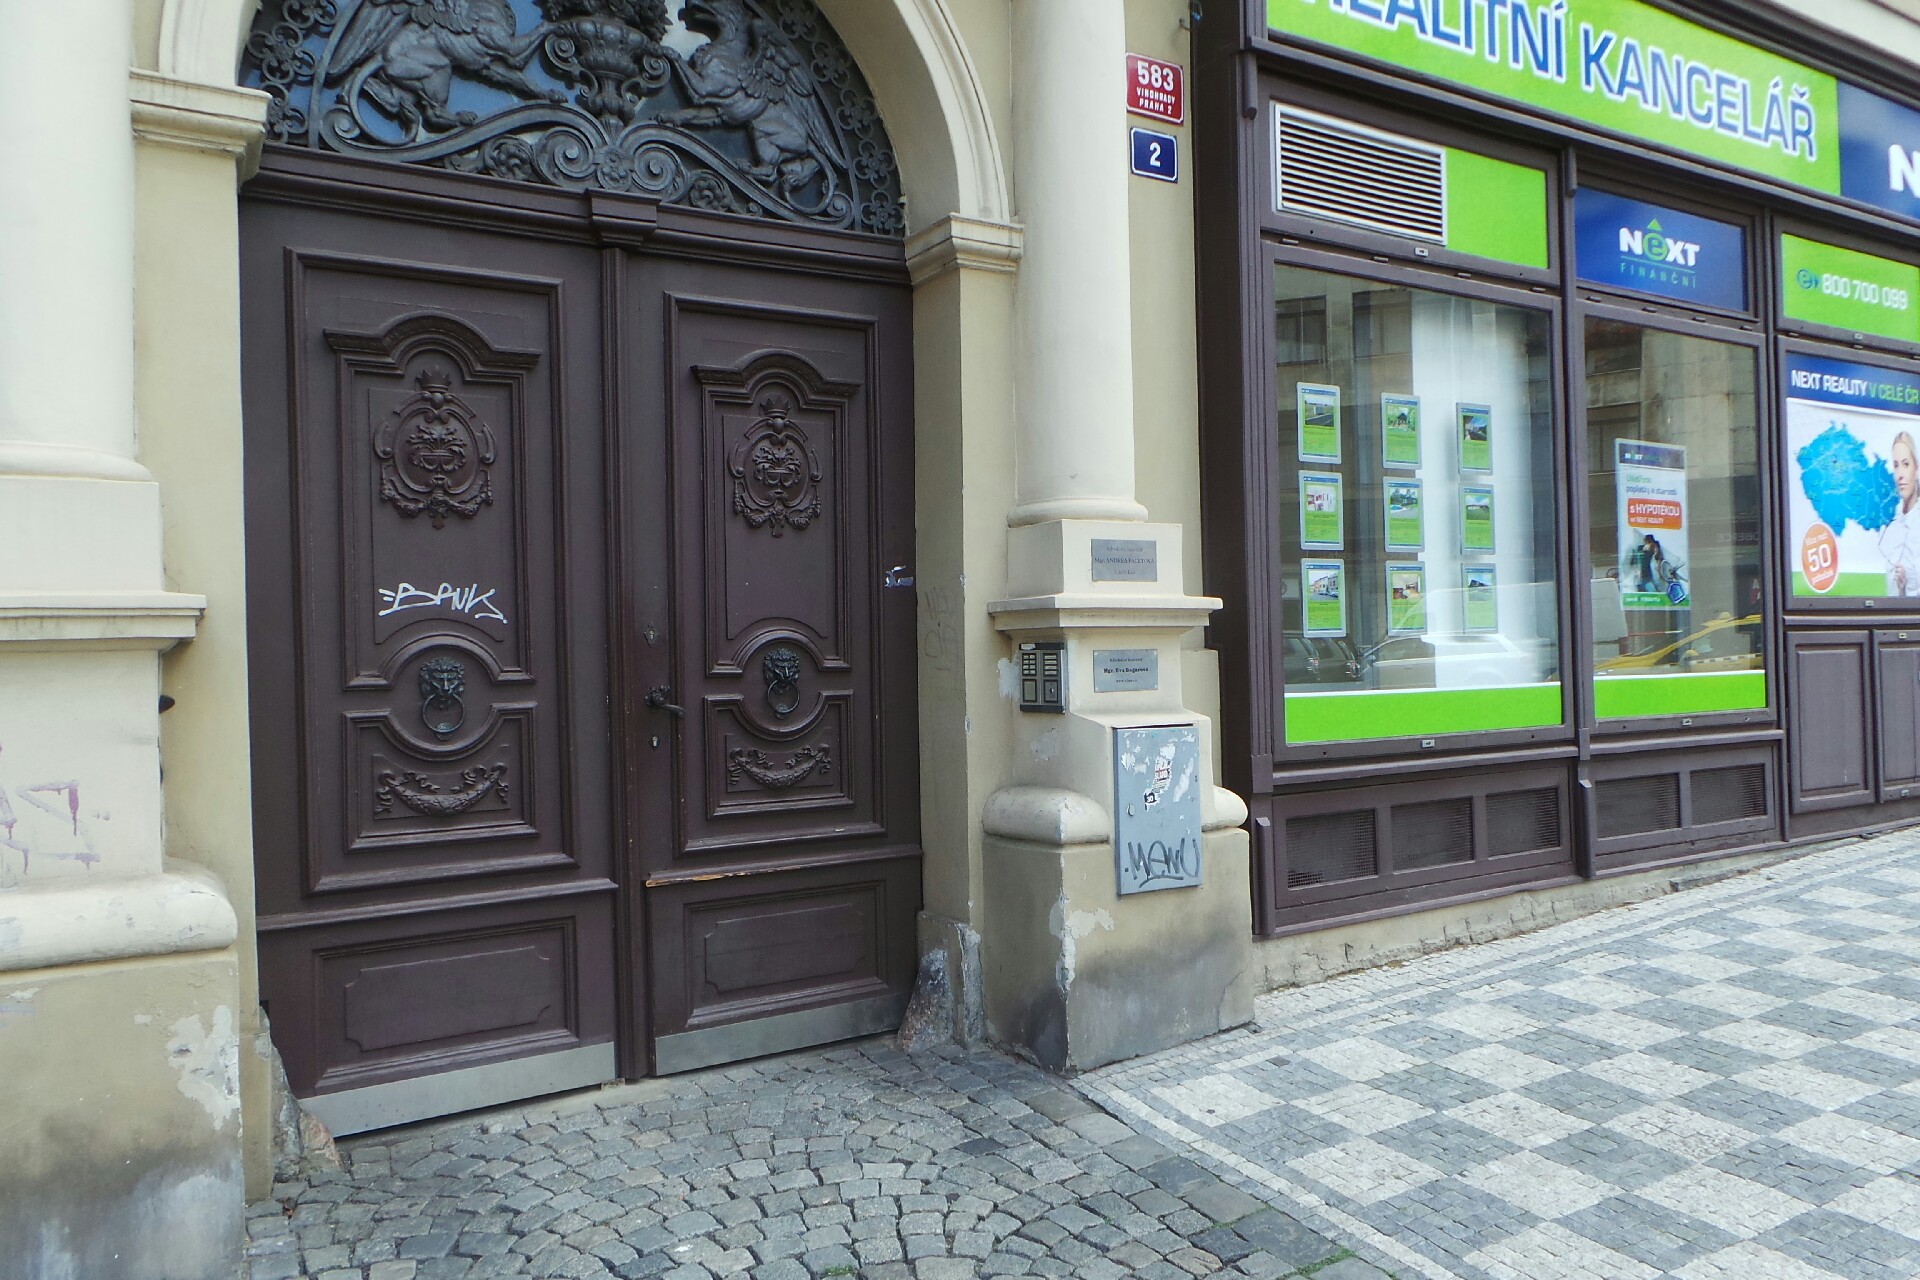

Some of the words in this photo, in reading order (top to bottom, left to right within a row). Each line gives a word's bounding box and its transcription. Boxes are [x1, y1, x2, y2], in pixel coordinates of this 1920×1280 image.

[1137, 60, 1174, 92] 583
[1136, 87, 1176, 105] VINOHRADY
[1139, 98, 1165, 113] PRAHA
[1167, 105, 1173, 115] 2
[1580, 23, 1817, 162] KANCELÁŘ
[1149, 142, 1161, 168] 2
[1822, 273, 1850, 298] 800
[1852, 280, 1879, 304] 700
[1881, 286, 1908, 310] 099
[1791, 369, 1821, 390] NEXT
[1822, 374, 1869, 397] REALITY
[1868, 382, 1878, 398] V
[1878, 383, 1904, 402] CELÉ
[1636, 503, 1680, 516] HYPOTÉKOU
[1808, 544, 1831, 572] 50
